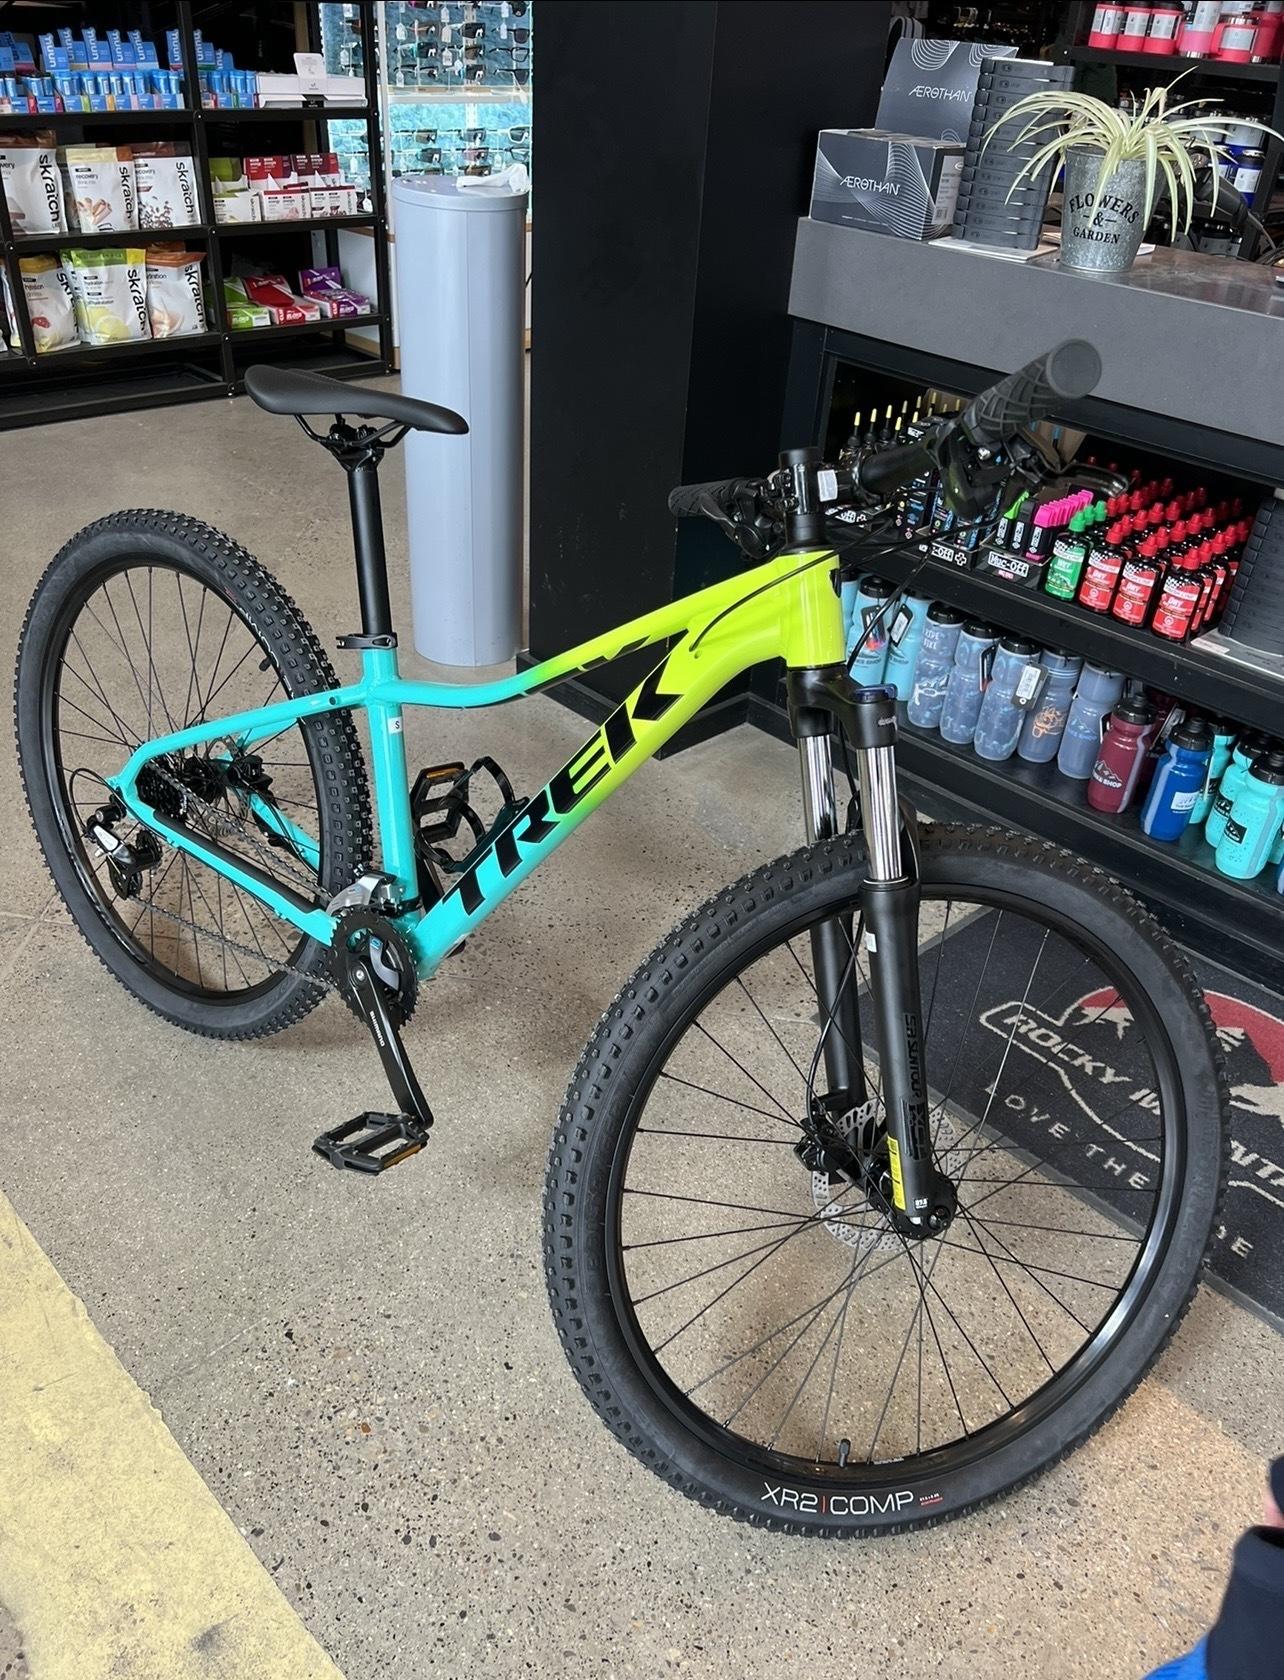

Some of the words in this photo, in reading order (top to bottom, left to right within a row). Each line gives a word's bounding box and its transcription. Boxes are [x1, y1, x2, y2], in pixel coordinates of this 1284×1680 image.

[45, 36, 57, 68] nuun
[87, 29, 99, 60] nuun
[112, 31, 124, 62] nuun
[132, 30, 146, 60] nuun
[171, 30, 181, 62] nuun
[193, 30, 204, 61] nuun
[39, 154, 60, 222] skratch
[175, 162, 195, 214] skratch
[1068, 192, 1139, 224] FLOWERS
[1073, 226, 1121, 244] GARDEN
[395, 720, 400, 730] S
[442, 628, 690, 917] TREK
[370, 1010, 386, 1048] SHIMANO
[1003, 1014, 1133, 1085] ROCKY
[1086, 1142, 1150, 1190] THE
[761, 1482, 818, 1513] XR2
[829, 1490, 914, 1516] COMP
